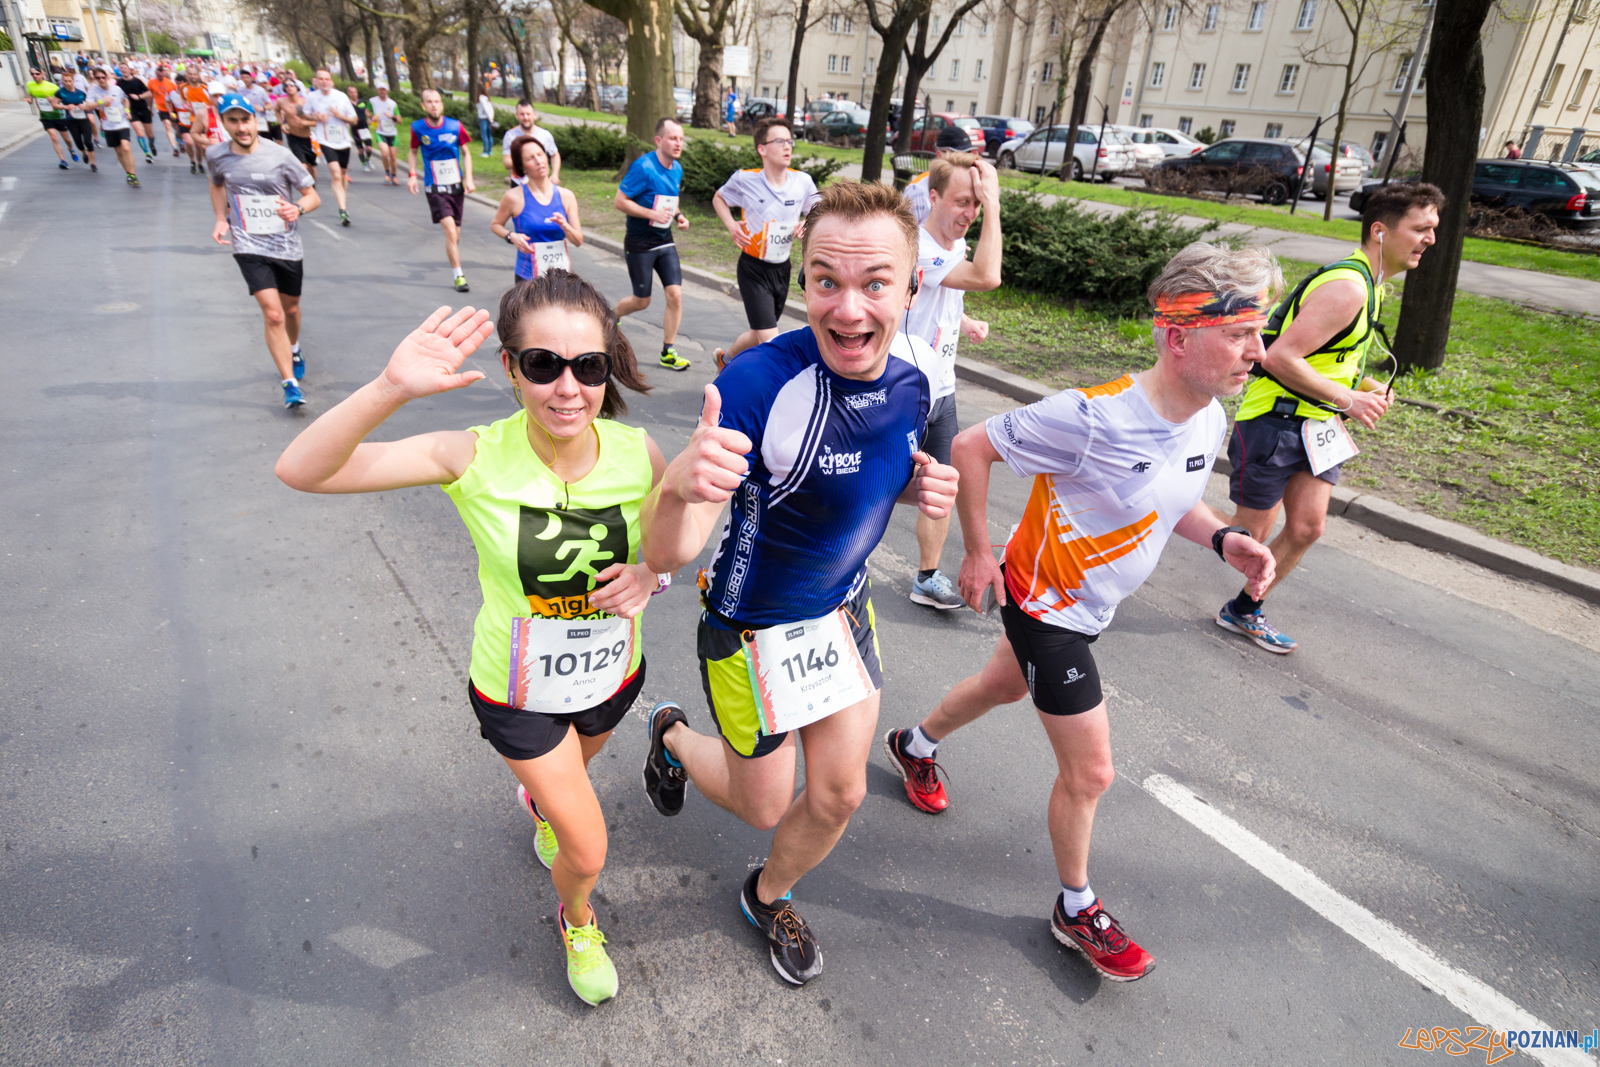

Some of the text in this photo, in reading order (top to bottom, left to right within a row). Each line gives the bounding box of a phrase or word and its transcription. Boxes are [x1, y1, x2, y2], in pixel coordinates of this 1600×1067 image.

[542, 252, 563, 263] 9291
[941, 342, 956, 357] 98
[1131, 461, 1152, 473] 4F
[738, 481, 759, 555] EXTREME
[726, 554, 749, 600] HOBBY
[548, 594, 589, 615] nig
[539, 639, 626, 677] 10129
[781, 640, 839, 683] 1146
[572, 677, 596, 686] Anna
[800, 674, 832, 693] Krzysztof
